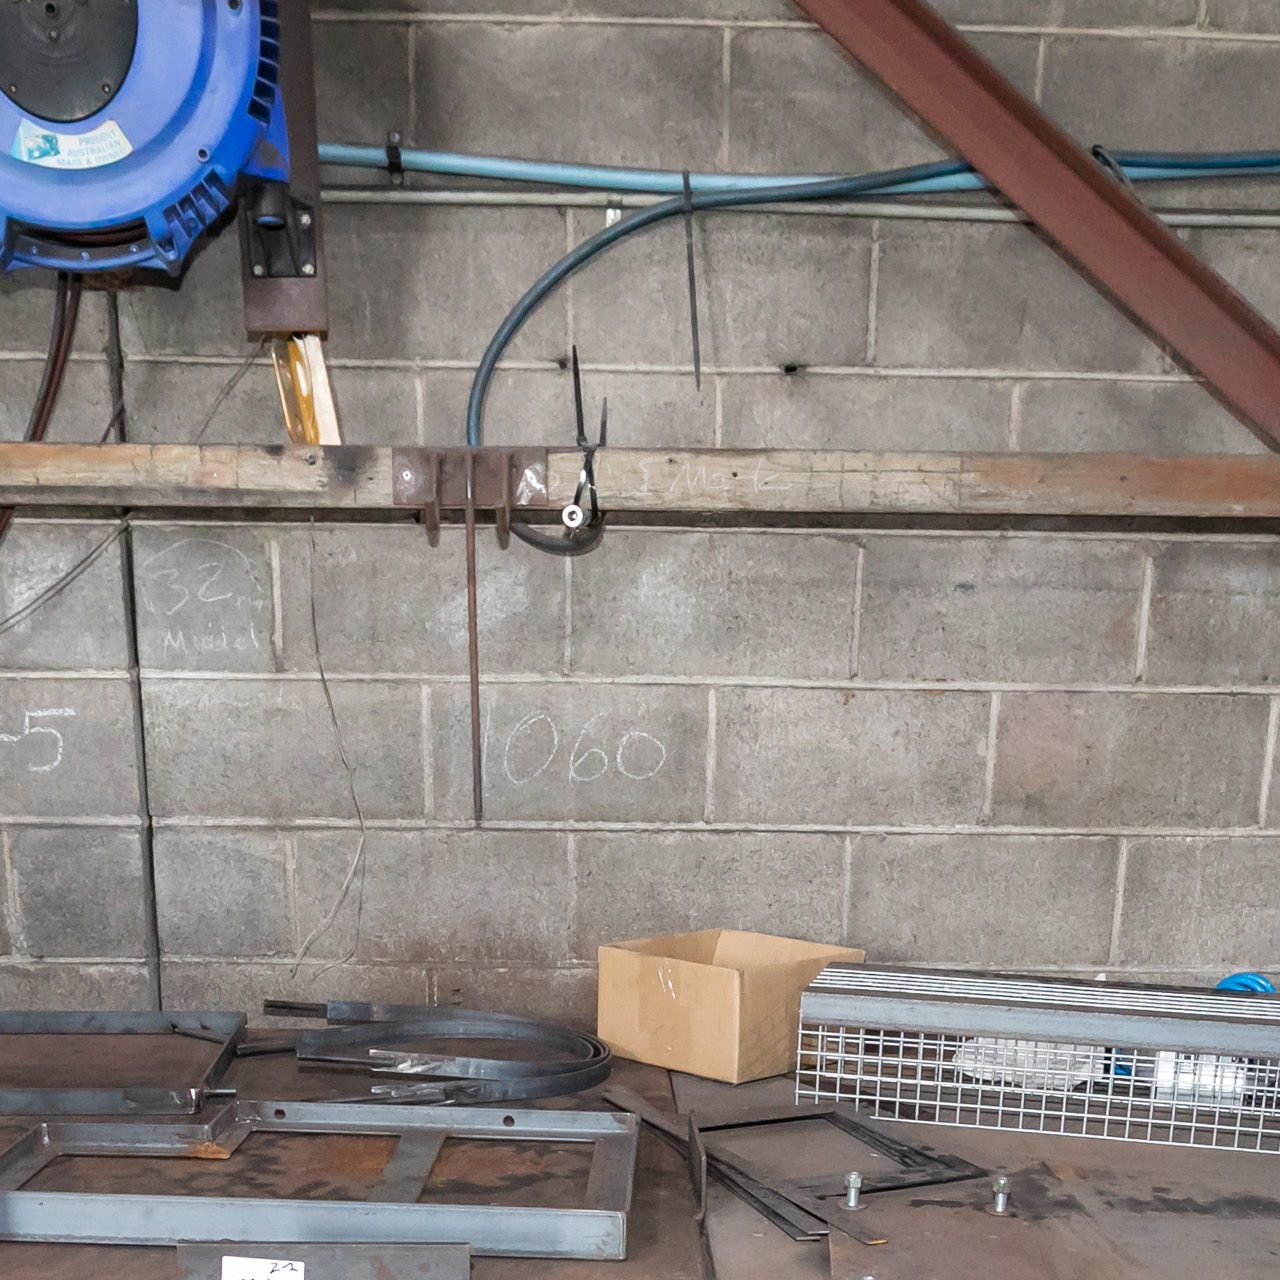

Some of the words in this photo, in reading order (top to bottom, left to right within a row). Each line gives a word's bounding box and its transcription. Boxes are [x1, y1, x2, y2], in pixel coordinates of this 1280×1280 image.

[78, 130, 116, 146] PROUDLY
[56, 157, 82, 166] MADE
[94, 147, 126, 163] OWNED
[67, 140, 121, 157] AUSTRALIAN
[483, 706, 667, 797] 1060
